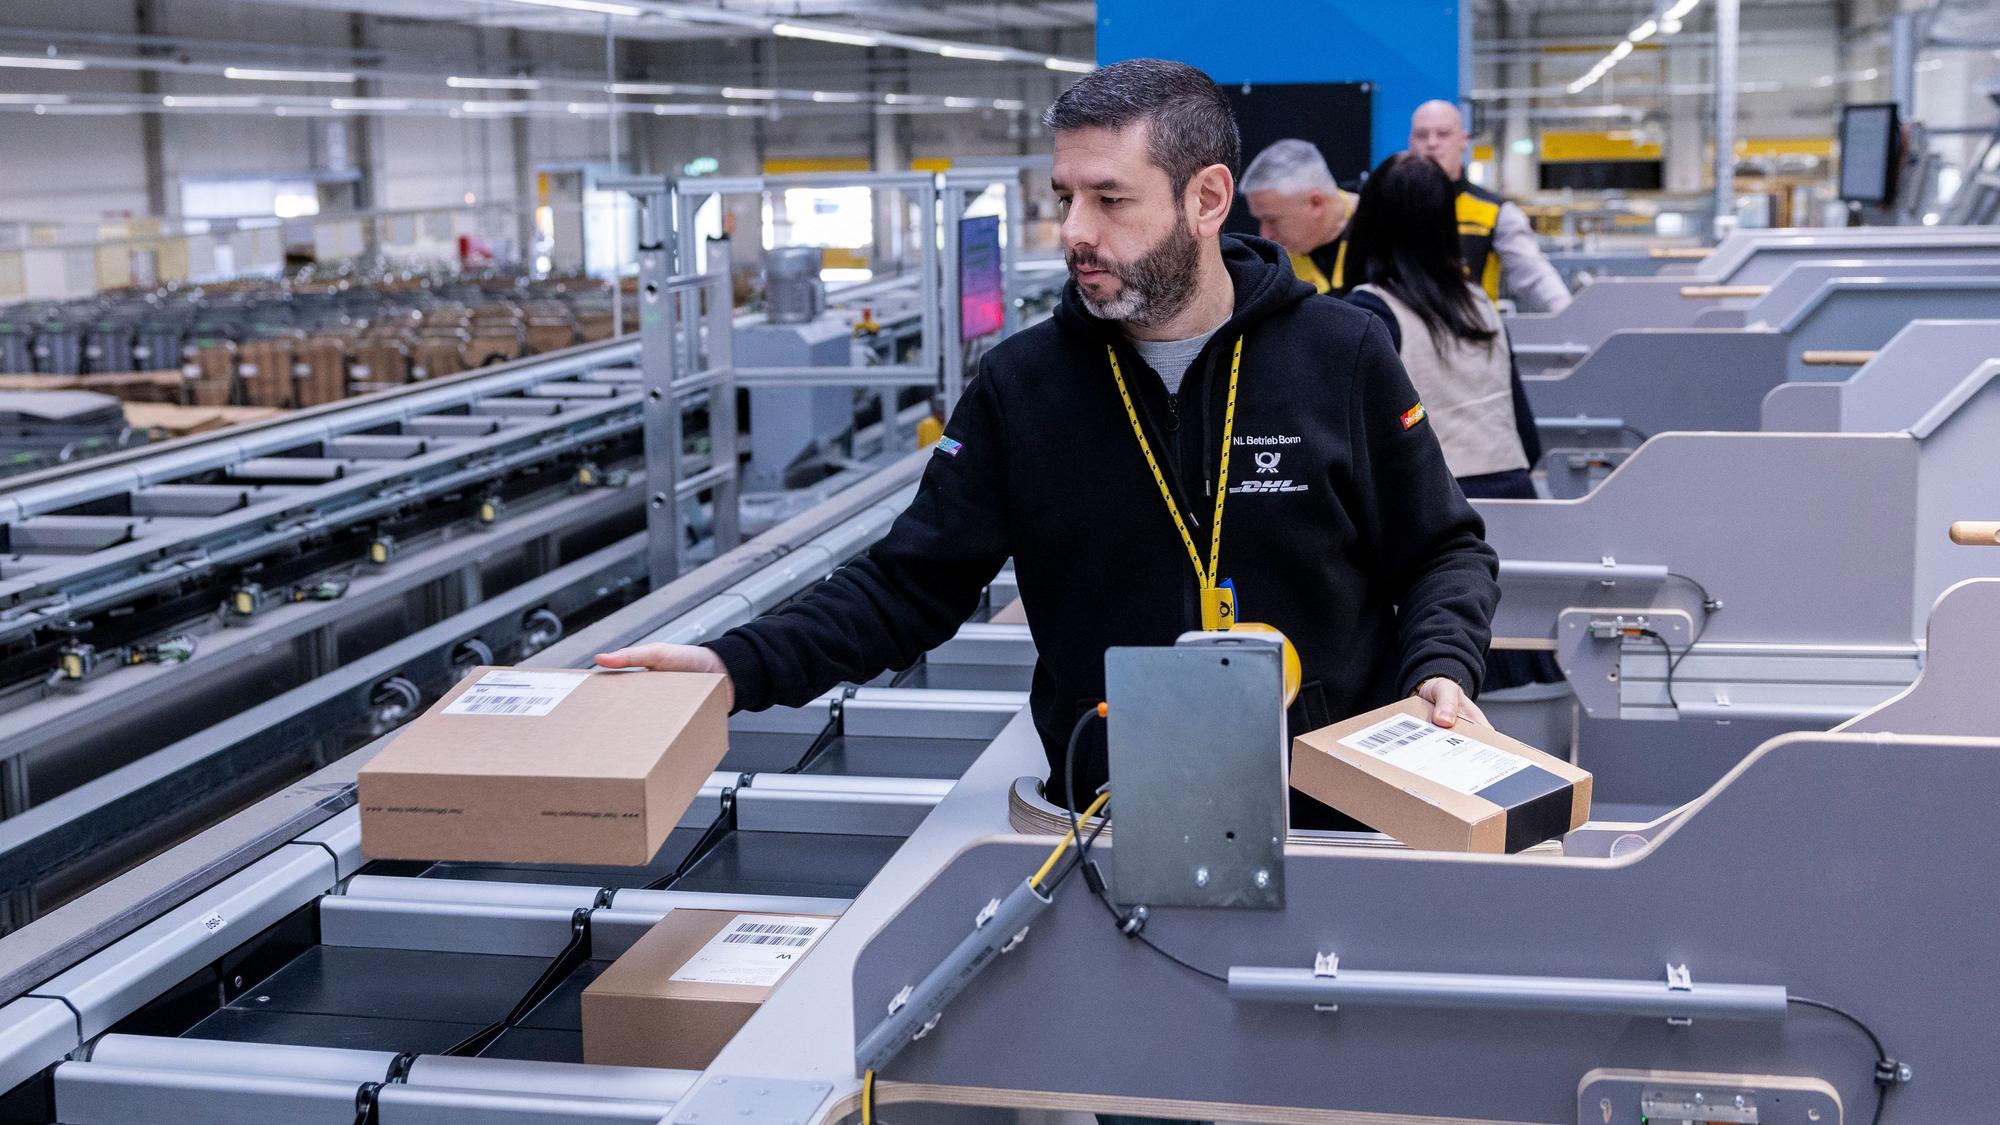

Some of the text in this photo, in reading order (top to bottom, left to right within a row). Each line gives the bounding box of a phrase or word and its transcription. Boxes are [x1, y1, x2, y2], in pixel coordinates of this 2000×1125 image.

[1233, 434, 1301, 446] NL Betrieb Bonn
[1240, 480, 1298, 493] DHL
